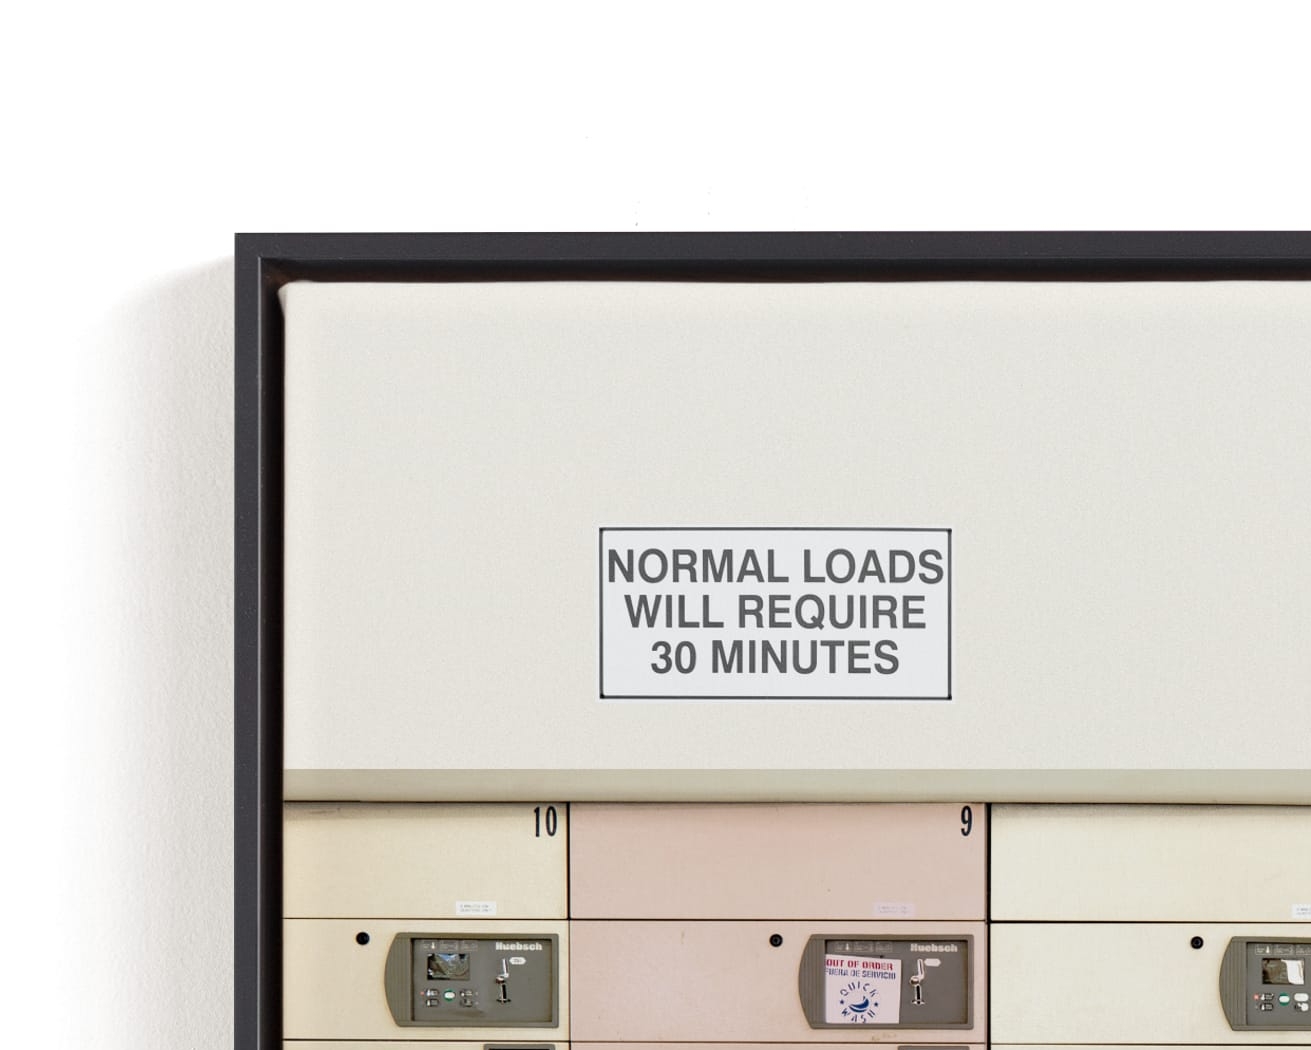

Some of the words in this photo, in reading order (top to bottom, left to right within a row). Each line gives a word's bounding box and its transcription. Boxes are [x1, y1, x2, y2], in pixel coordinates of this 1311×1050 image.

[608, 548, 789, 584] NORMAL
[803, 548, 944, 585] LOADS
[623, 594, 724, 629] WILL
[738, 593, 926, 630] REQUIRE
[650, 640, 697, 675] 30
[711, 639, 899, 675] MINUTES
[532, 805, 557, 837] 10
[961, 805, 973, 836] 9
[495, 941, 543, 951] Huebsch
[910, 943, 958, 953] Huebsch
[826, 959, 844, 967] OUT
[848, 960, 859, 968] OF
[862, 961, 893, 971] ORDER
[840, 981, 878, 997] QUICK
[841, 1008, 876, 1023] WASH
